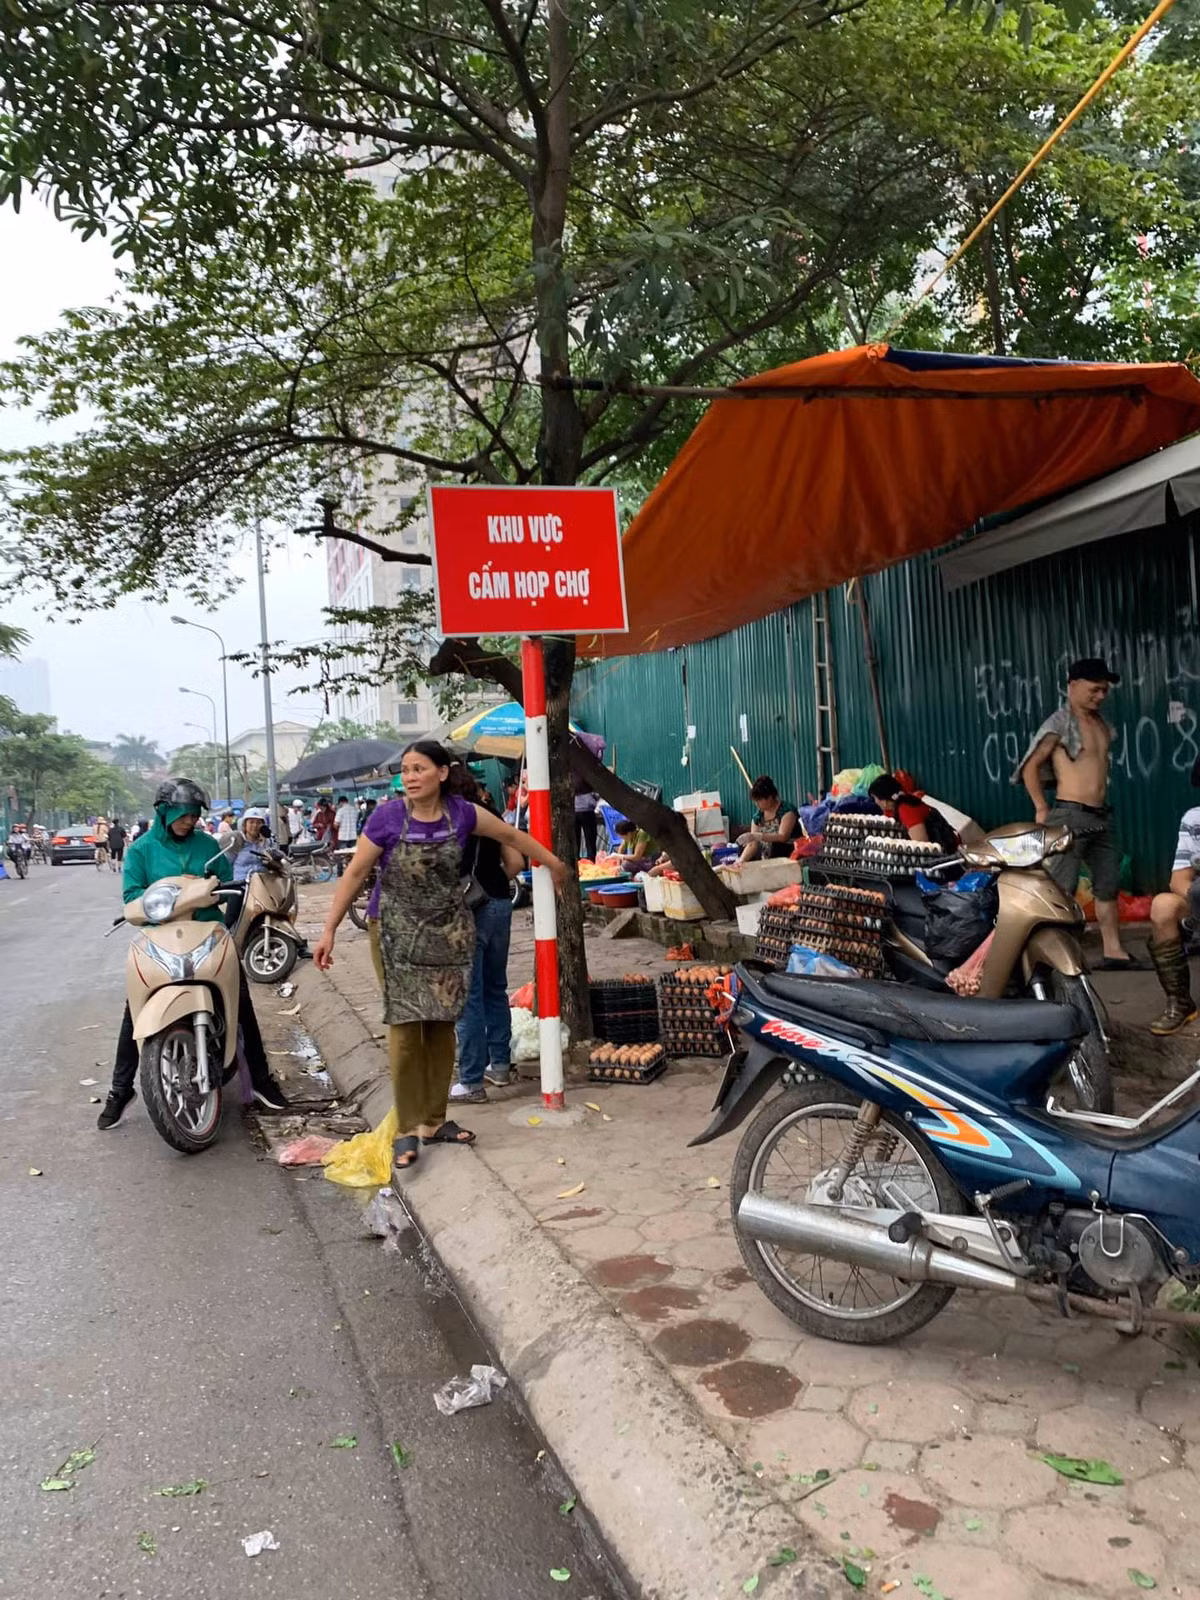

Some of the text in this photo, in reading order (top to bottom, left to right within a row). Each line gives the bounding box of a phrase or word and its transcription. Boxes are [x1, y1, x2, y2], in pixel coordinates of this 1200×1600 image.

[487, 513, 563, 551] KHU VỰC
[468, 561, 590, 606] CẤM HỌP CHỢ
[761, 1019, 826, 1050] Wave
